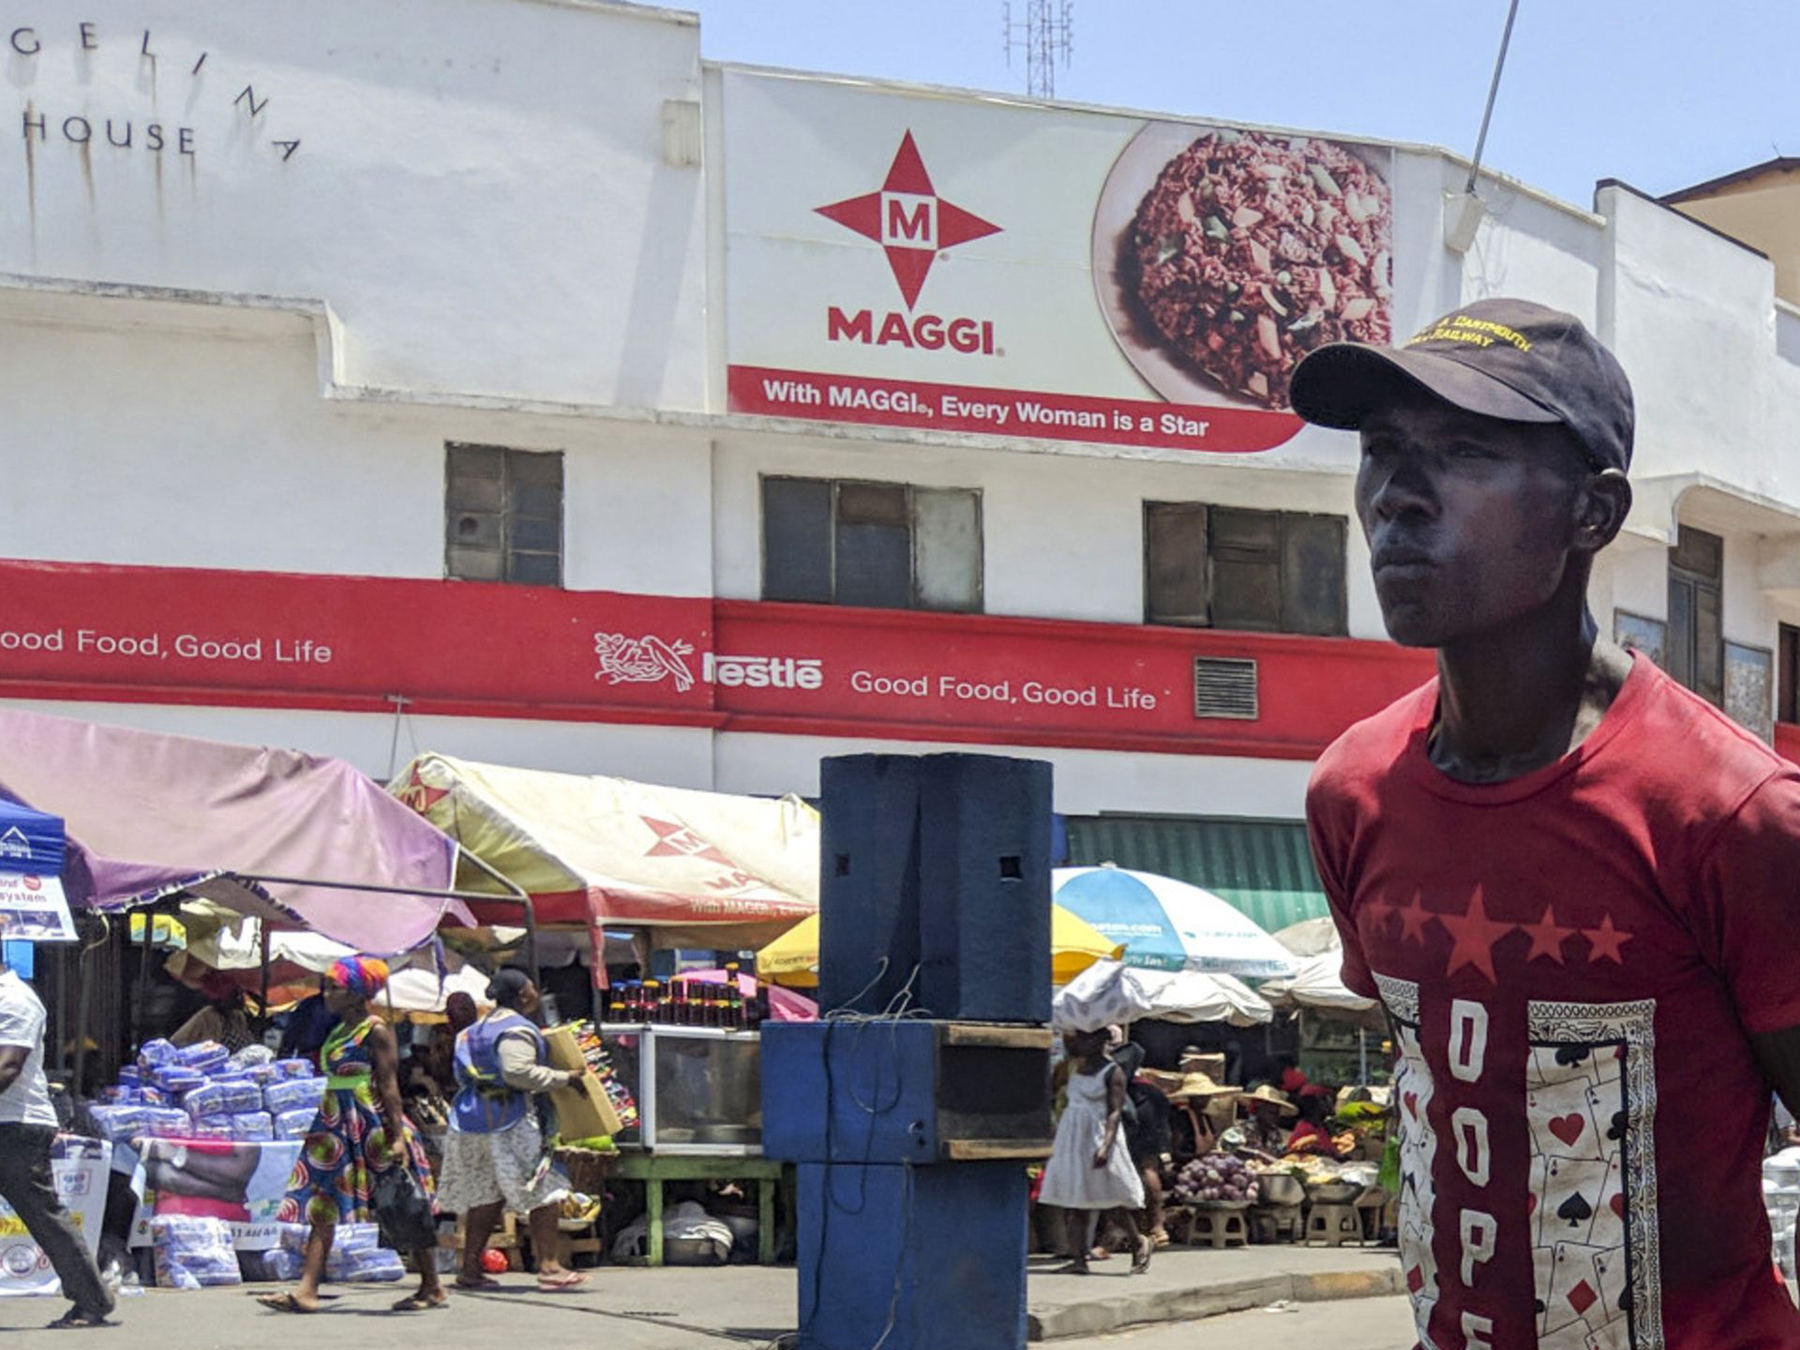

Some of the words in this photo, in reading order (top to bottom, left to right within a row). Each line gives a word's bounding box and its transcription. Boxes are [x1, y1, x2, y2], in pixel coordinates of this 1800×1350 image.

[22, 111, 195, 155] HOUSE
[888, 199, 931, 241] M
[763, 379, 821, 405] With
[941, 395, 1009, 424] Every
[1015, 402, 1106, 428] Woman
[1113, 410, 1133, 431] is
[1140, 417, 1154, 432] a
[1160, 413, 1209, 436] Star
[0, 629, 63, 652] ood
[77, 629, 167, 660] Food,
[174, 634, 262, 662] Good
[275, 639, 332, 663] Life
[850, 670, 929, 697] Good
[939, 676, 1018, 704] Food,
[1022, 682, 1097, 707] Good
[1107, 686, 1157, 710] Life
